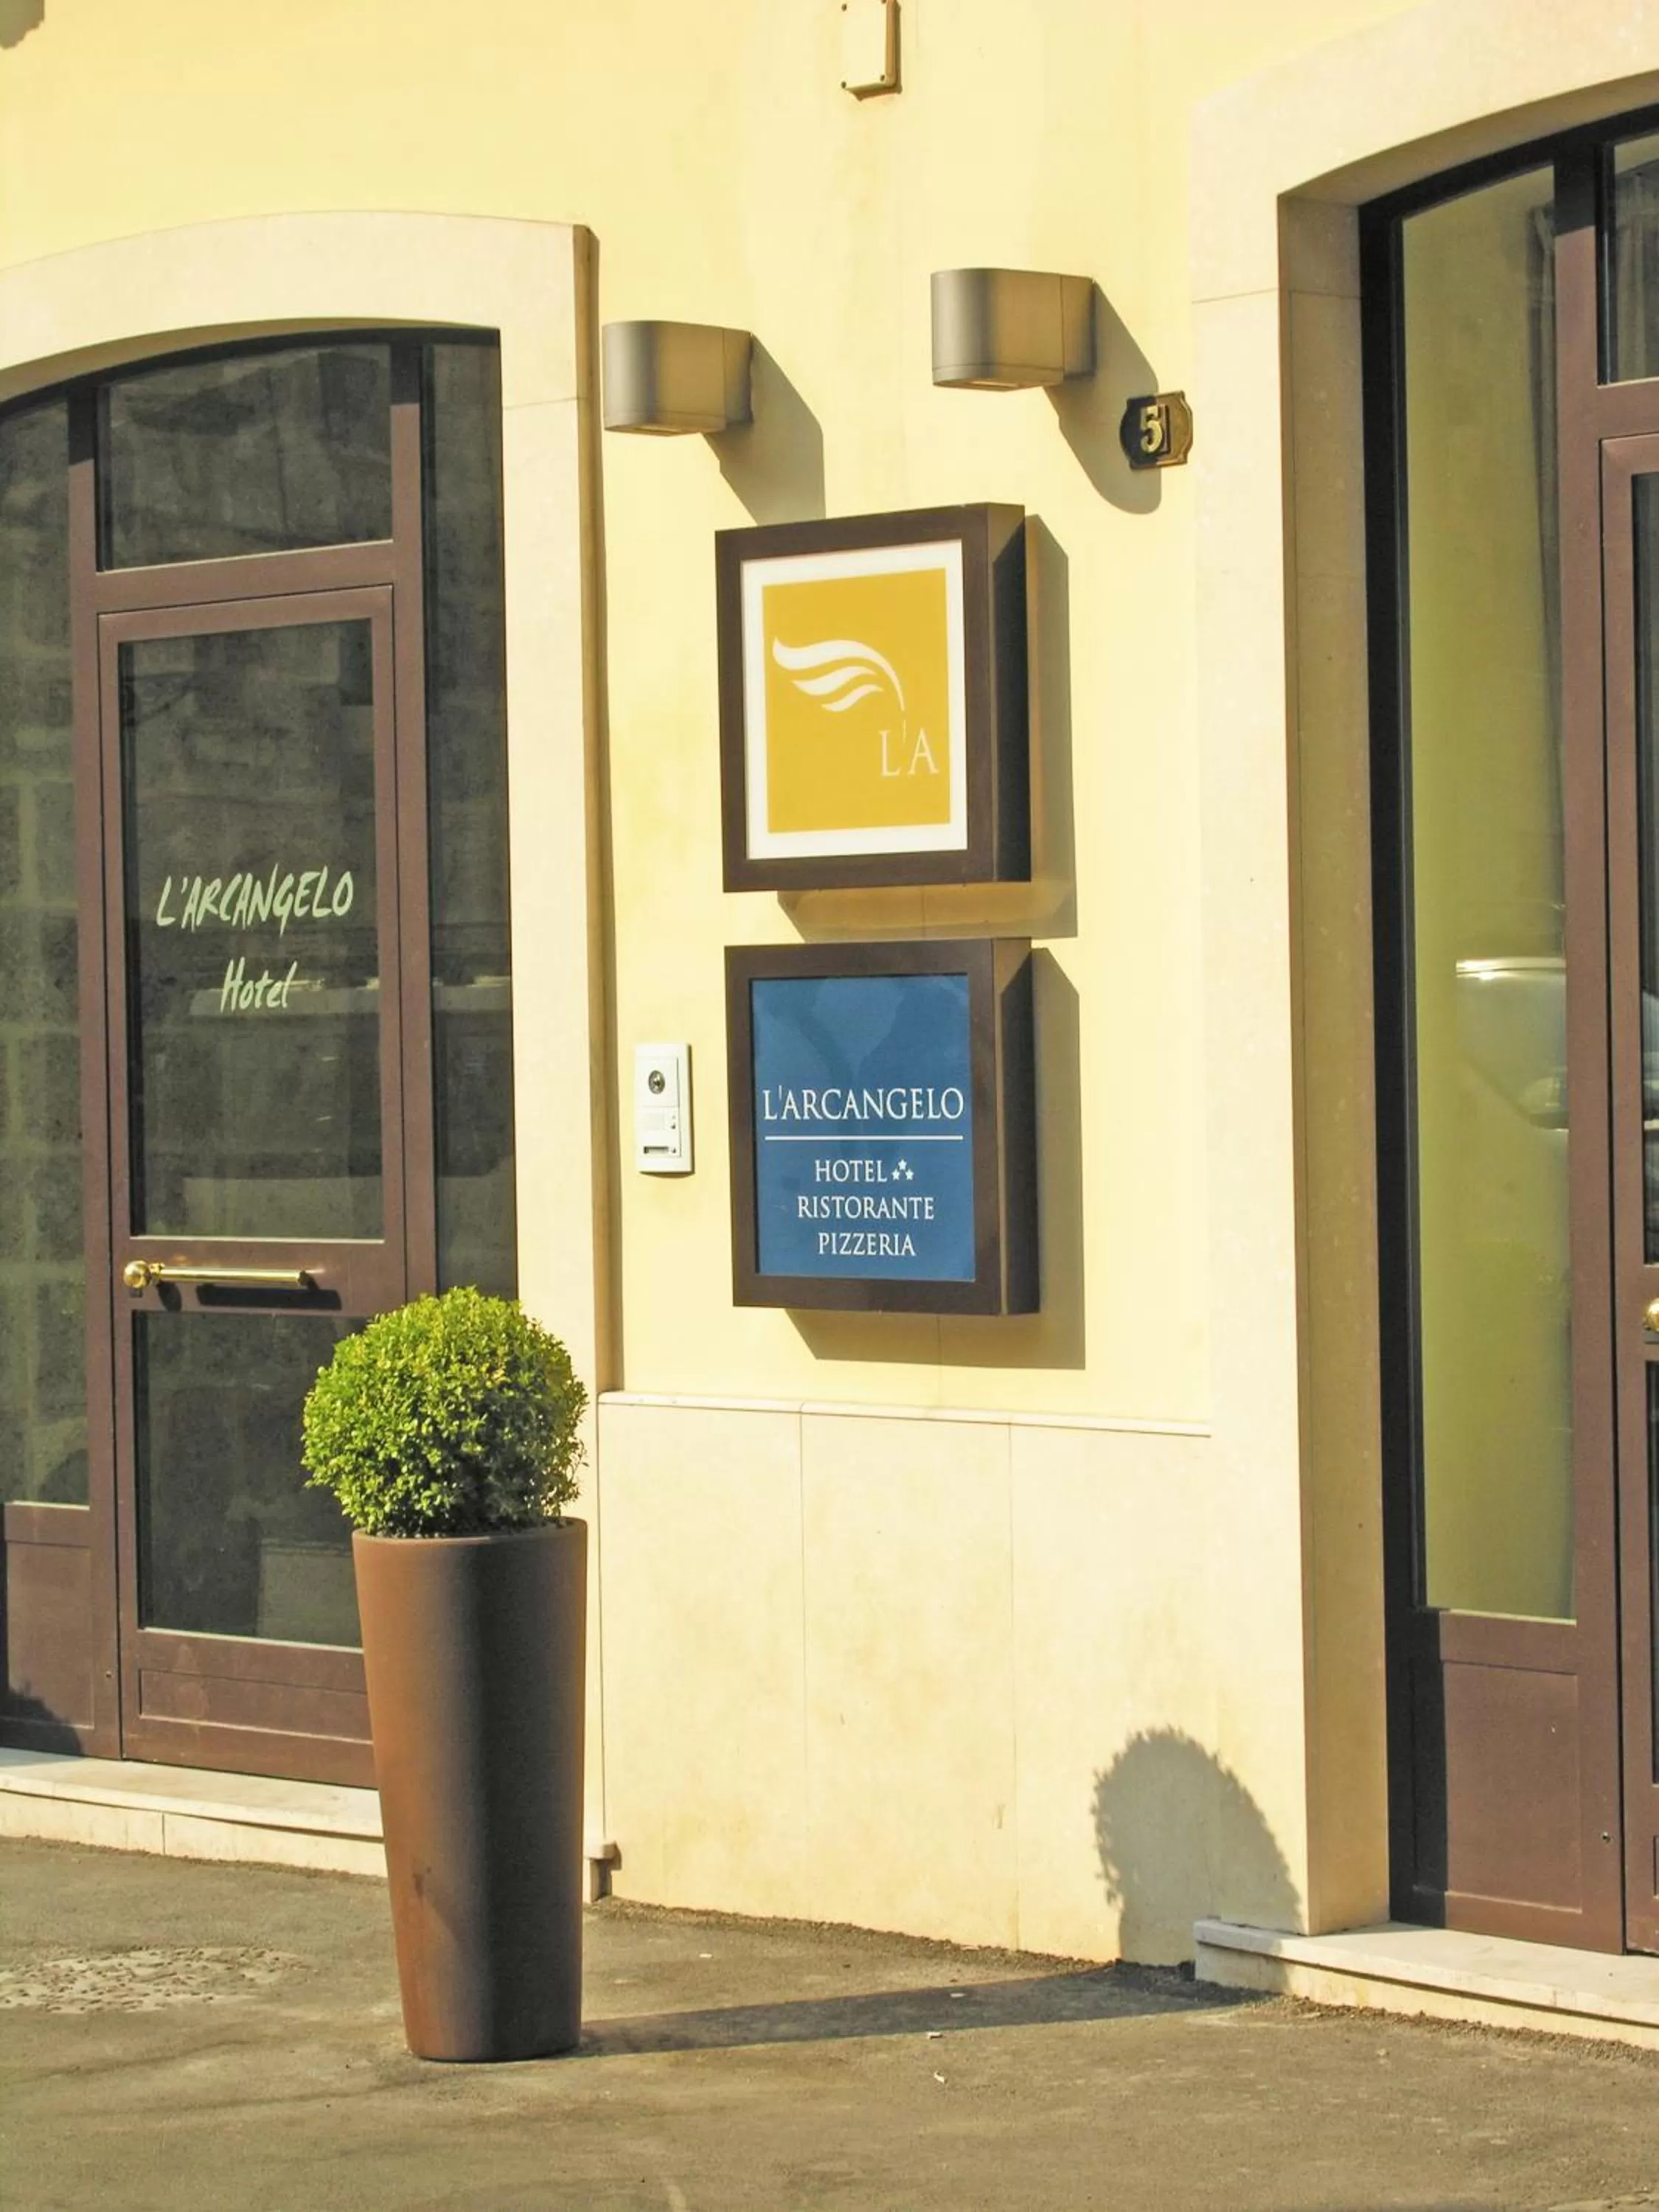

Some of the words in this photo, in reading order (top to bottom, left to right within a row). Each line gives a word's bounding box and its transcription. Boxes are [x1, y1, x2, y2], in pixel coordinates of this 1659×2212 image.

[156, 863, 354, 937] L'ARCANGELO
[220, 956, 297, 1013] Hotel
[762, 1085, 964, 1120] L'ARCANGELO
[815, 1159, 888, 1182] HOTEL
[798, 1195, 935, 1220] RISTORANTE
[818, 1232, 917, 1257] PIZZERIA
